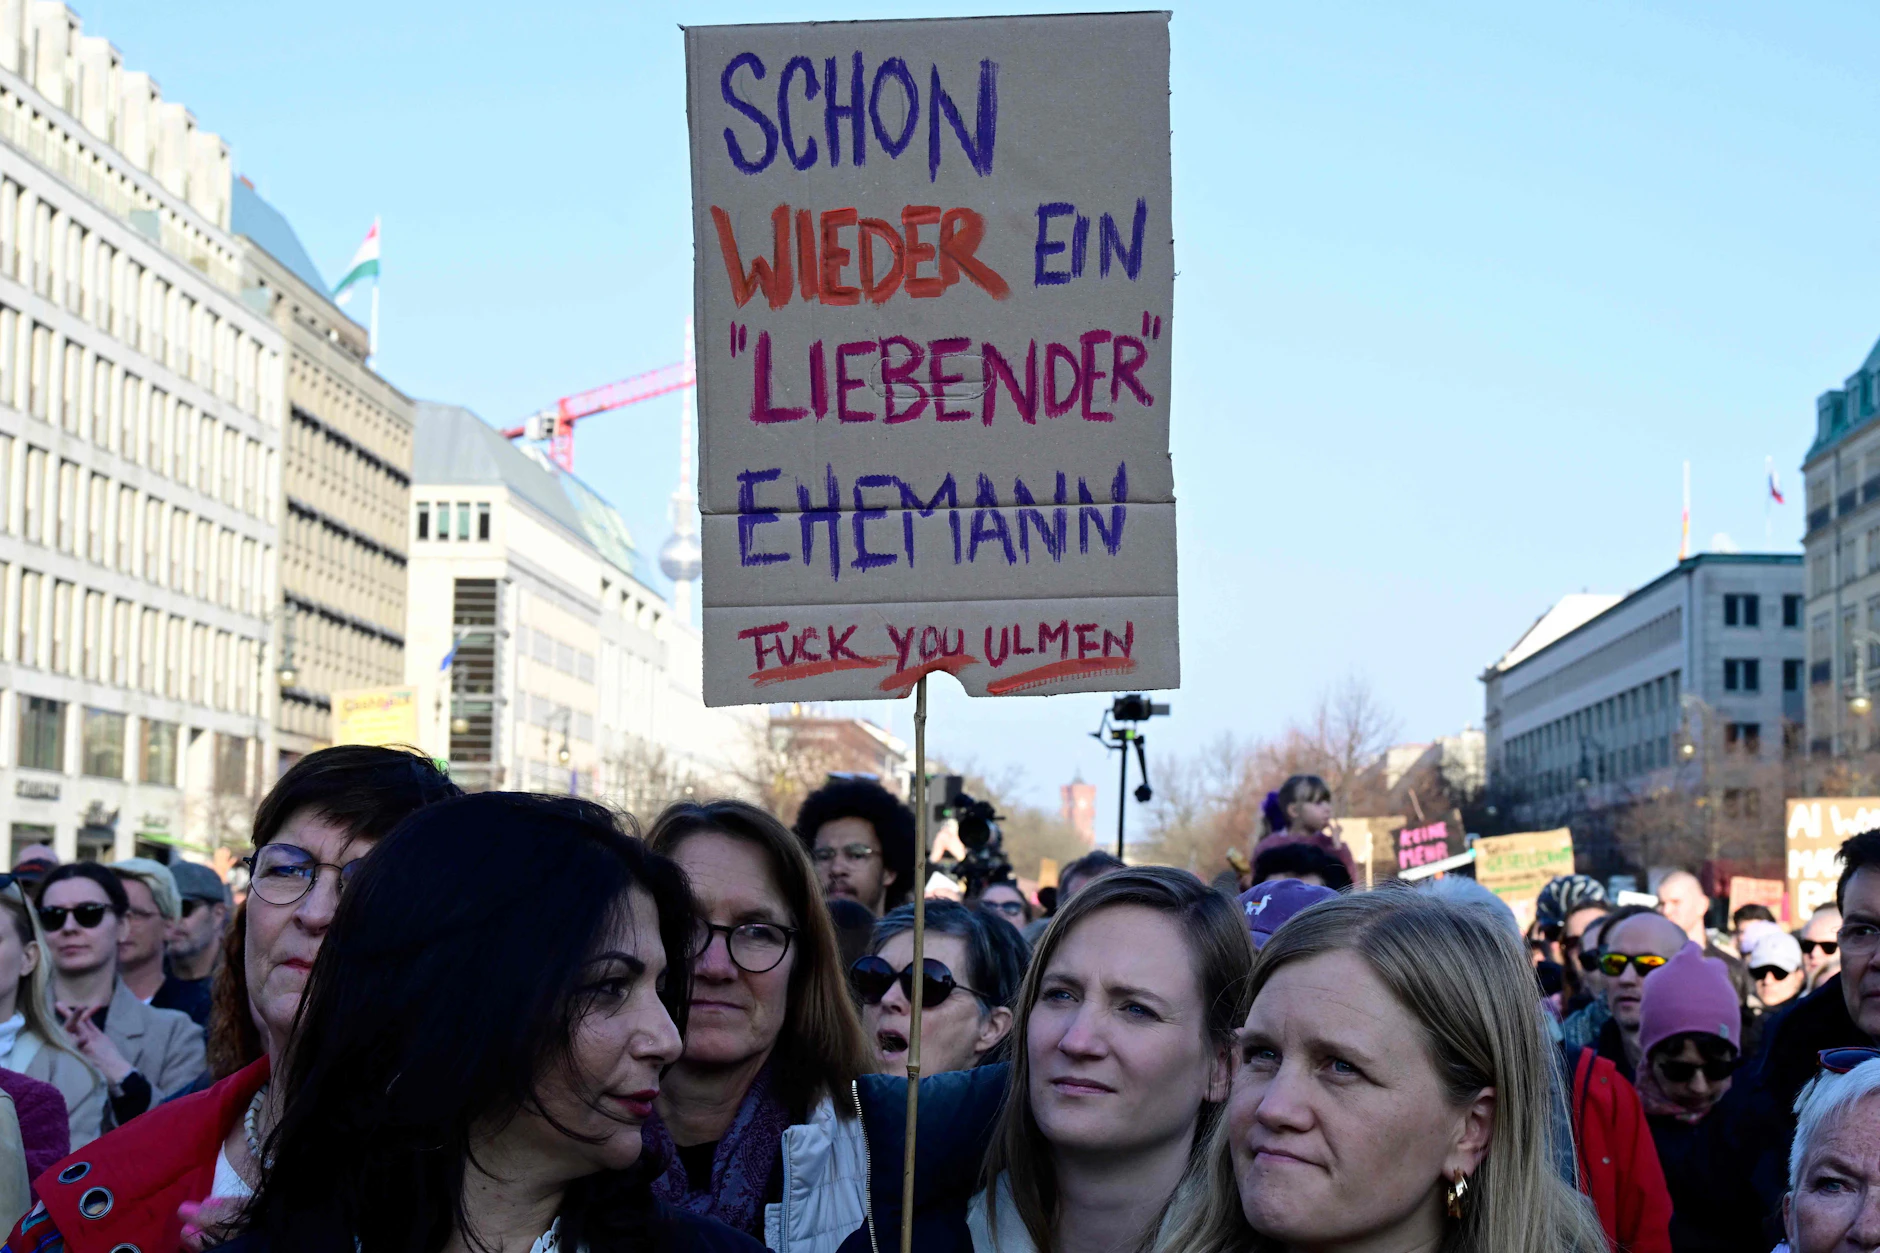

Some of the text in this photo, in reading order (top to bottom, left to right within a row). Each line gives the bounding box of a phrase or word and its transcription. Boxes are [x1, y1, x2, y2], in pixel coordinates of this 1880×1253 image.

[720, 50, 999, 183] SCHON
[710, 196, 1147, 310] WIEDER EIN
[730, 310, 1161, 427] "LIEBENDER"
[737, 460, 1129, 582] EHEMANN
[738, 619, 1134, 673] FUCK YOU ULMEN
[1398, 841, 1449, 870] MEHR
[1399, 821, 1448, 846] KEINE
[1787, 802, 1822, 838] AI
